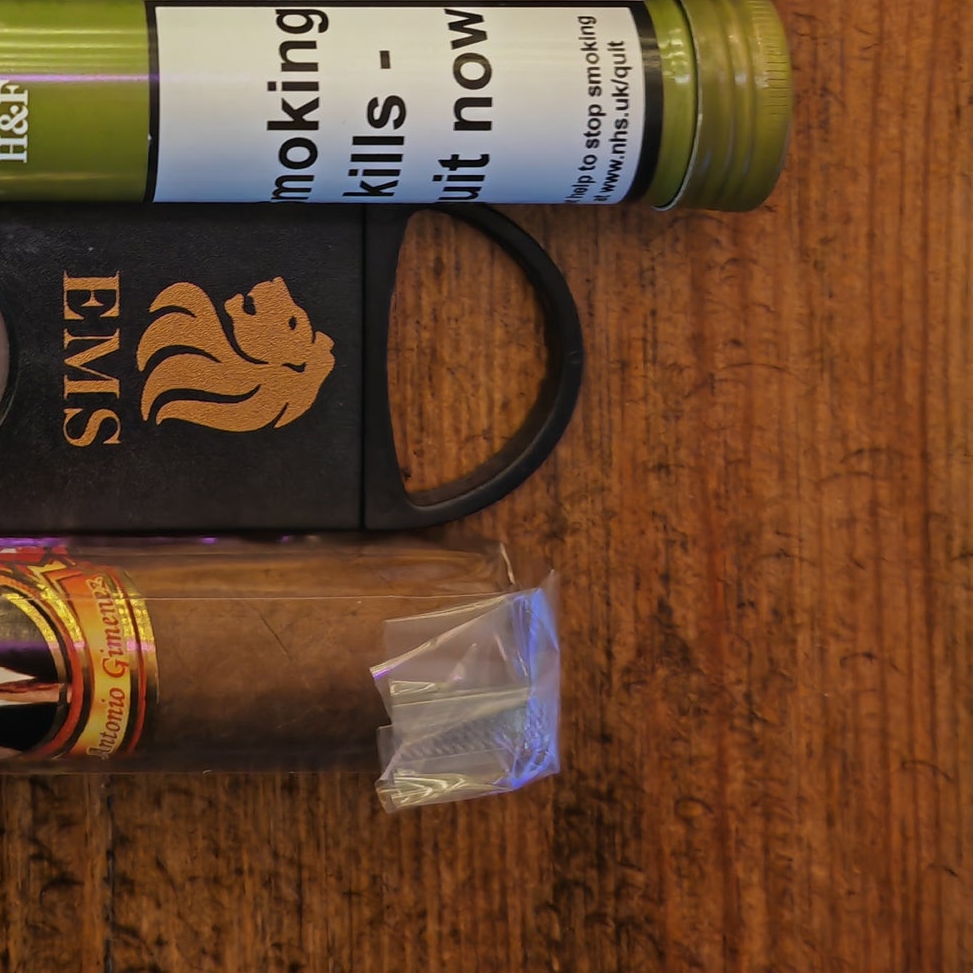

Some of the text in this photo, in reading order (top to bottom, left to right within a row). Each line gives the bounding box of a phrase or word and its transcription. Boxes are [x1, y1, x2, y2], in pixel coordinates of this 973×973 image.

[577, 15, 603, 98] smoking
[267, 8, 328, 202] moking
[343, 94, 407, 198] kills
[432, 8, 494, 202] uit now
[583, 103, 607, 149] stop
[599, 40, 633, 194] www.nhs.uk/quit
[565, 175, 597, 199] help
[578, 154, 598, 171] to
[63, 270, 122, 448] EMS
[87, 686, 126, 761] Antonio
